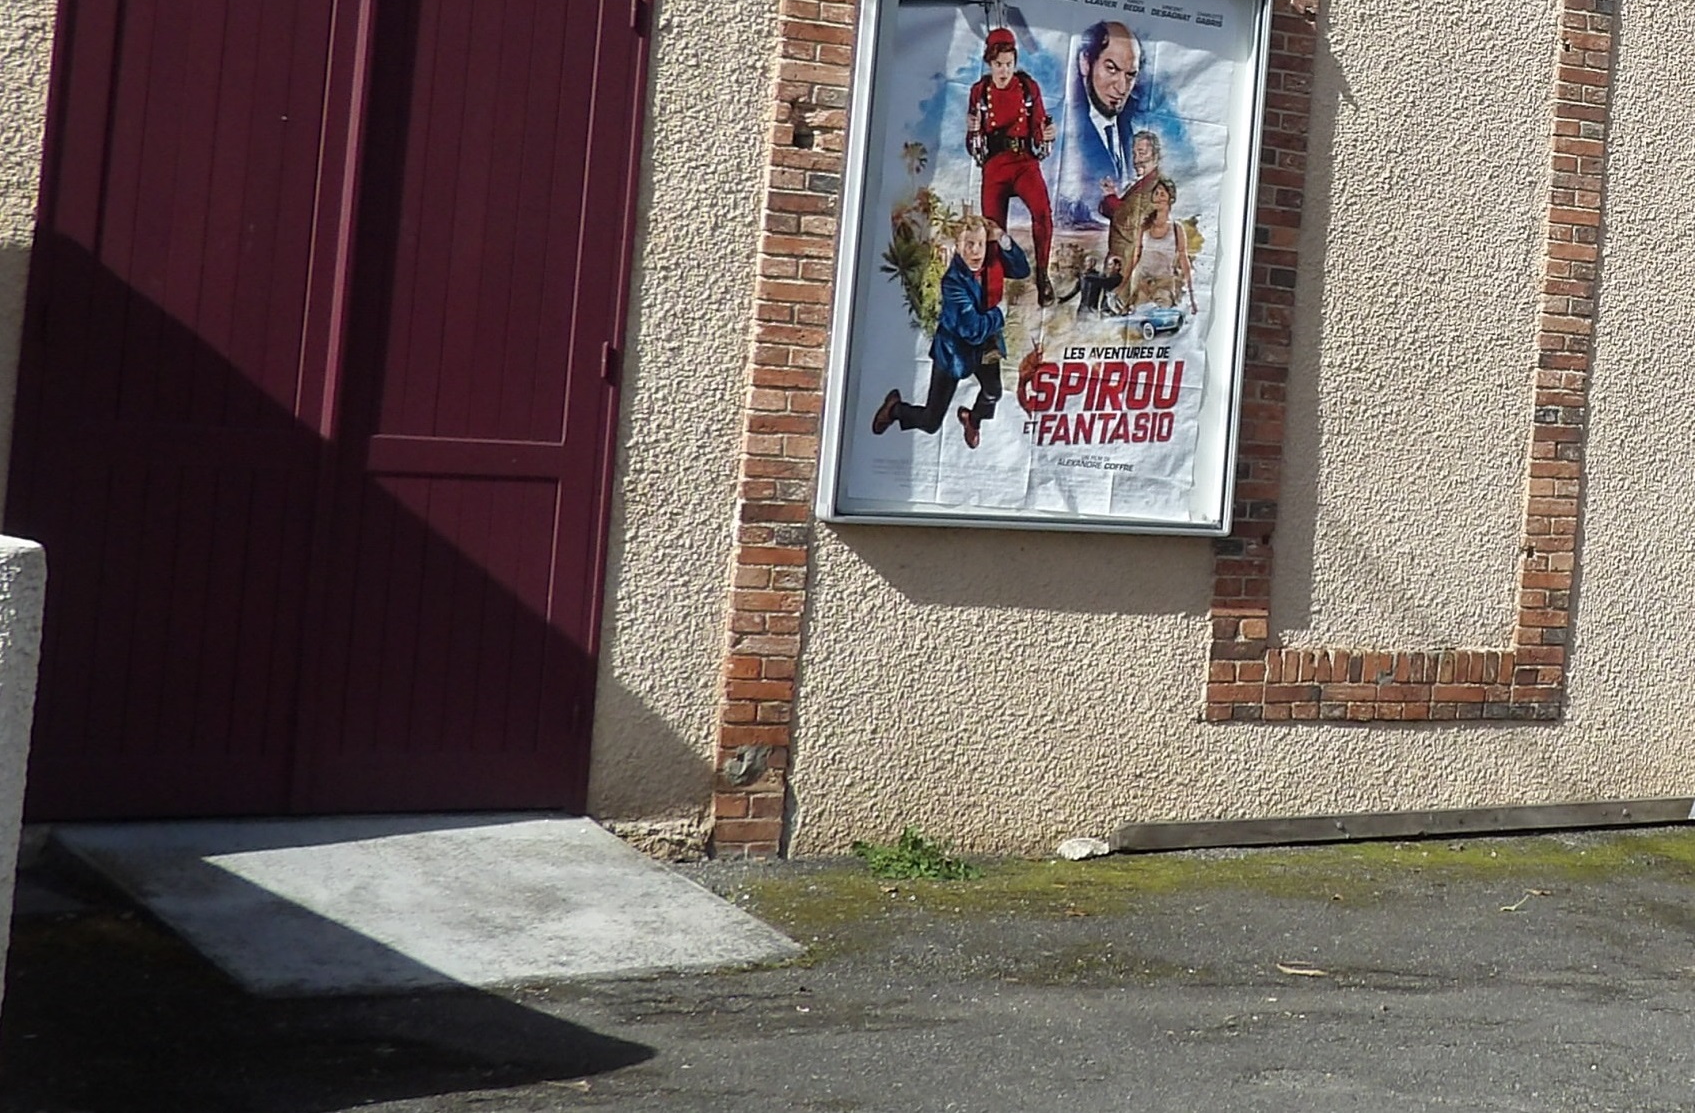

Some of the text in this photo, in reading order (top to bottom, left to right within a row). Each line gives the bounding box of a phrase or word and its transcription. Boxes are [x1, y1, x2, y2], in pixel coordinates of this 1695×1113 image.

[1123, 3, 1145, 13] BEDIA
[1063, 346, 1171, 360] LES AVENTURES DE
[1026, 360, 1185, 412] SPIROU
[1023, 411, 1175, 446] ET FANTASIO
[1057, 458, 1134, 472] ALEXANDRE COFFRE
